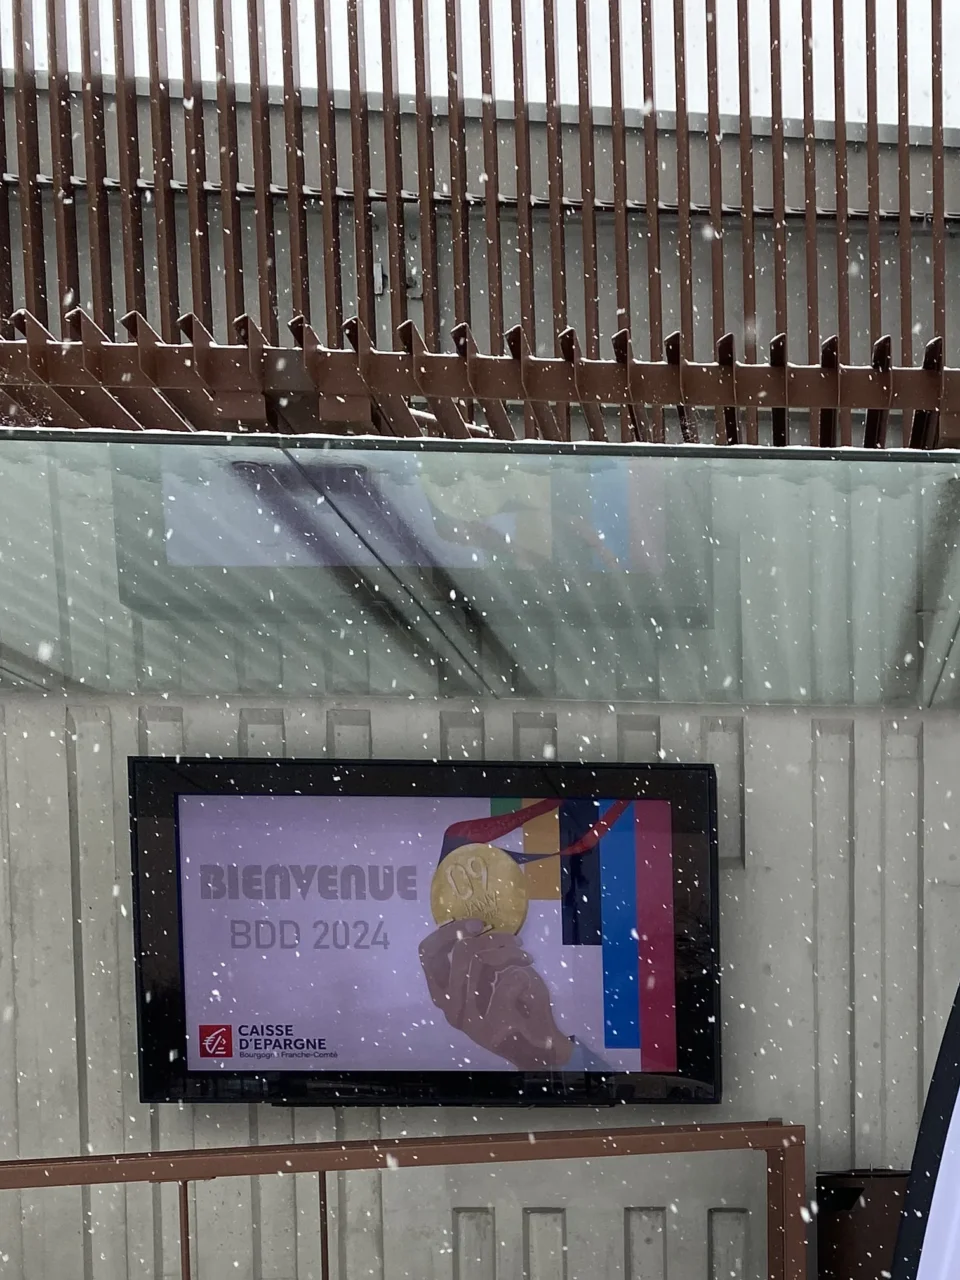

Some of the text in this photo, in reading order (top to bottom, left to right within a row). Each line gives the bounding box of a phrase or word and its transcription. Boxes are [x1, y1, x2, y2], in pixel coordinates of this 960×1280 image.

[199, 864, 417, 901] BIENVENUE
[230, 920, 390, 949] BDD 2024
[238, 1025, 294, 1036] CAISSE
[239, 1038, 327, 1050] D'EPARGNE
[239, 1051, 279, 1059] Bourgogn
